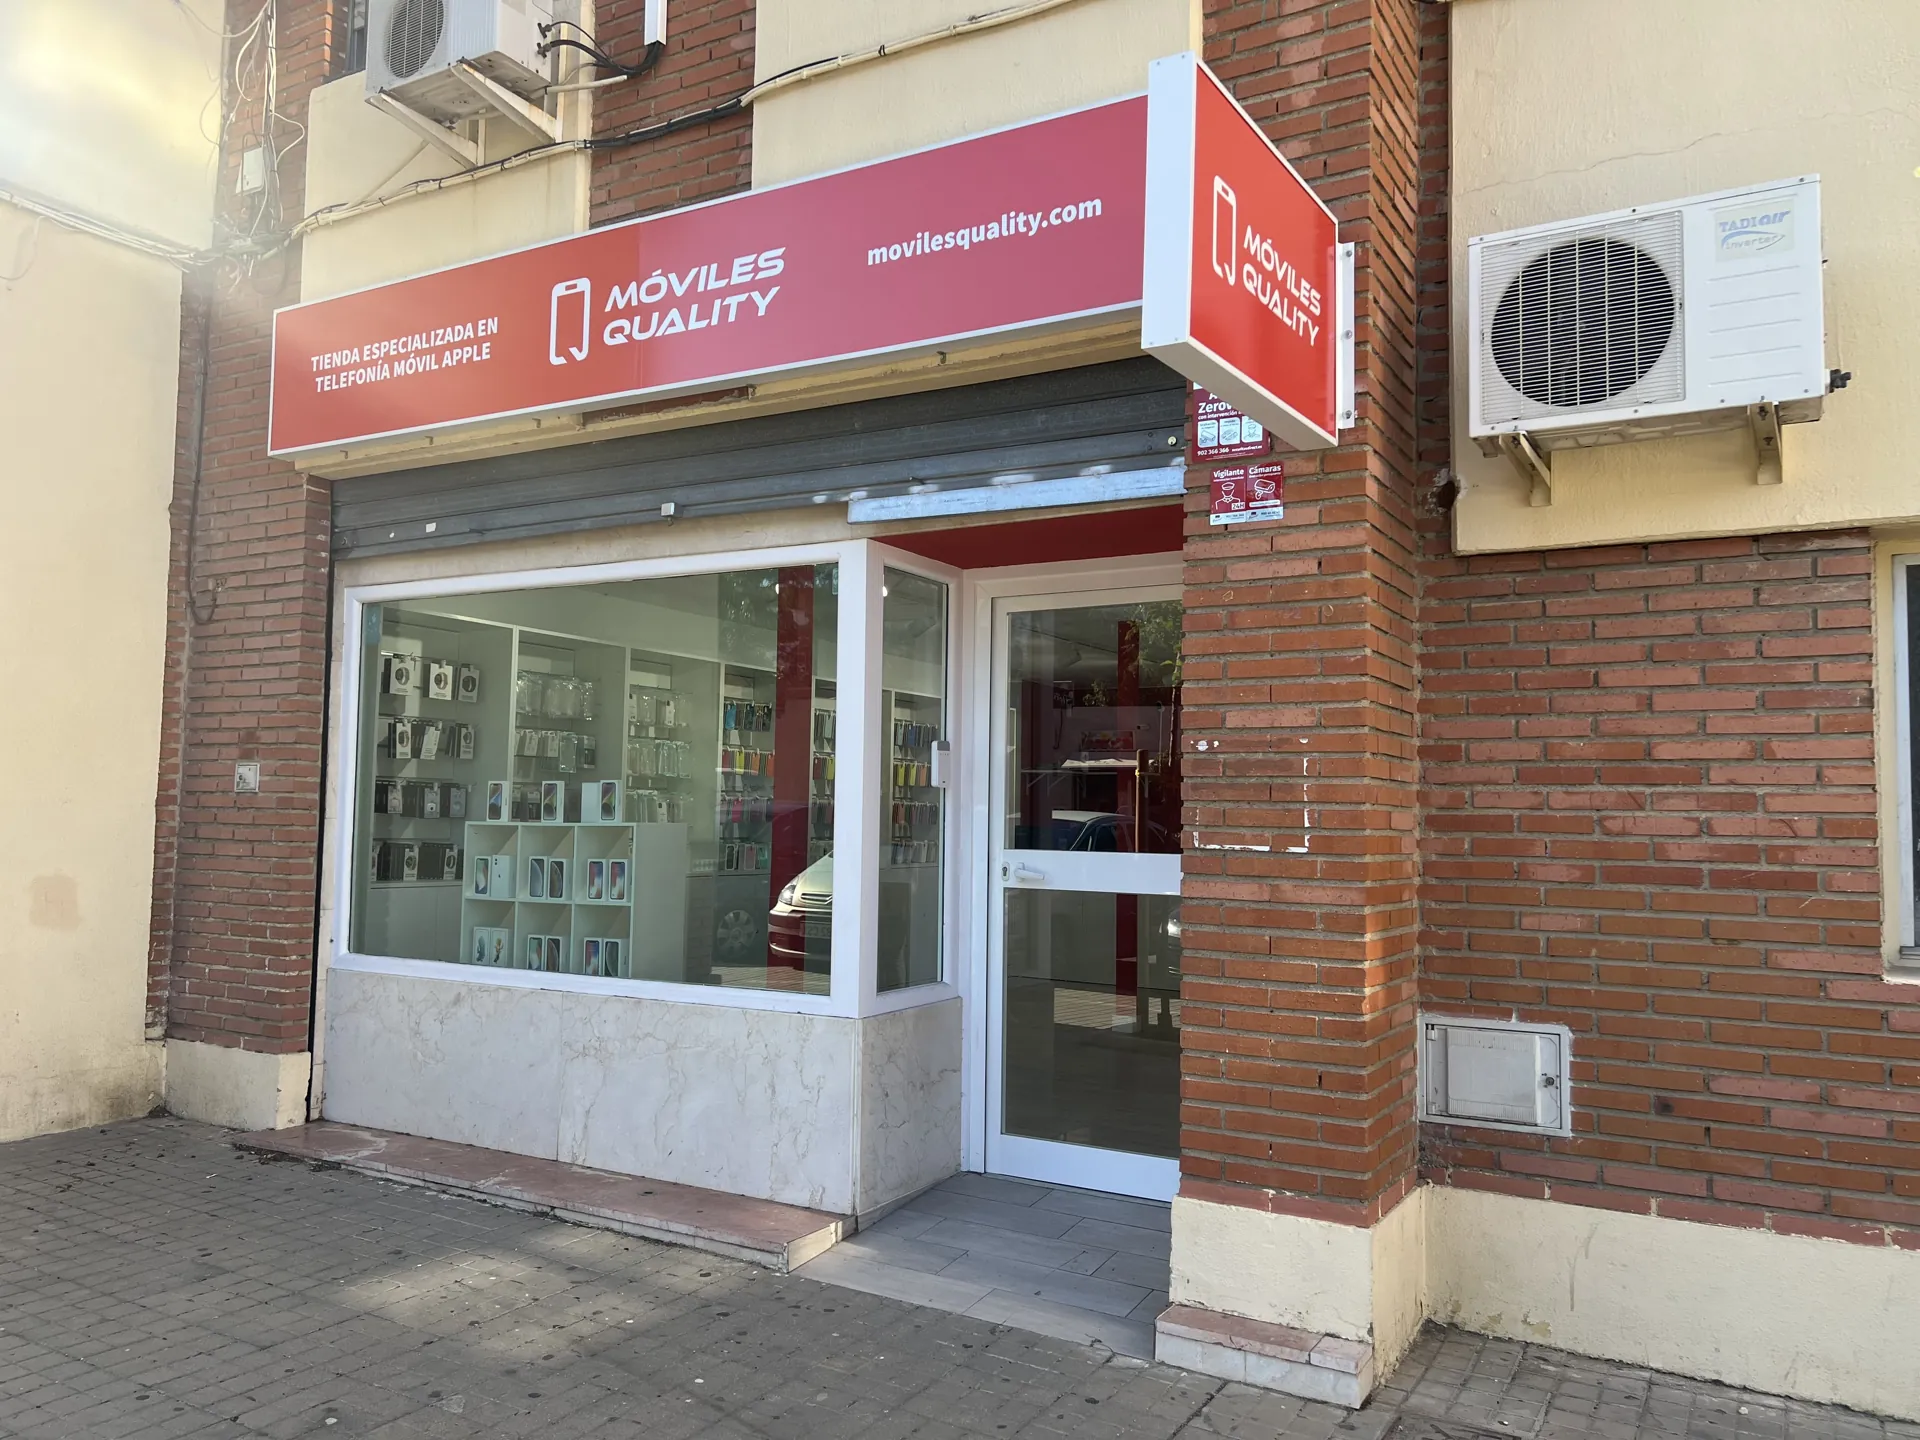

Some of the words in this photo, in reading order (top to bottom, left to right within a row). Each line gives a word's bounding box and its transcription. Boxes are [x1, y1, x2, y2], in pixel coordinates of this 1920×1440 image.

[867, 198, 1102, 266] movilesquality.com
[604, 246, 786, 312] MÓVILES
[1242, 225, 1321, 317] MÓVILES
[603, 286, 781, 346] QUALITY
[1242, 262, 1320, 347] QUALITY
[310, 348, 361, 373] TIENDA
[362, 323, 475, 362] ESPECIALIZADA
[477, 316, 498, 337] EN
[315, 358, 391, 393] TELEFONÍA
[393, 350, 439, 378] MÓVIL
[442, 341, 491, 369] APPLE
[1213, 468, 1244, 478] Vigilante
[1248, 464, 1282, 475] Cámaras
